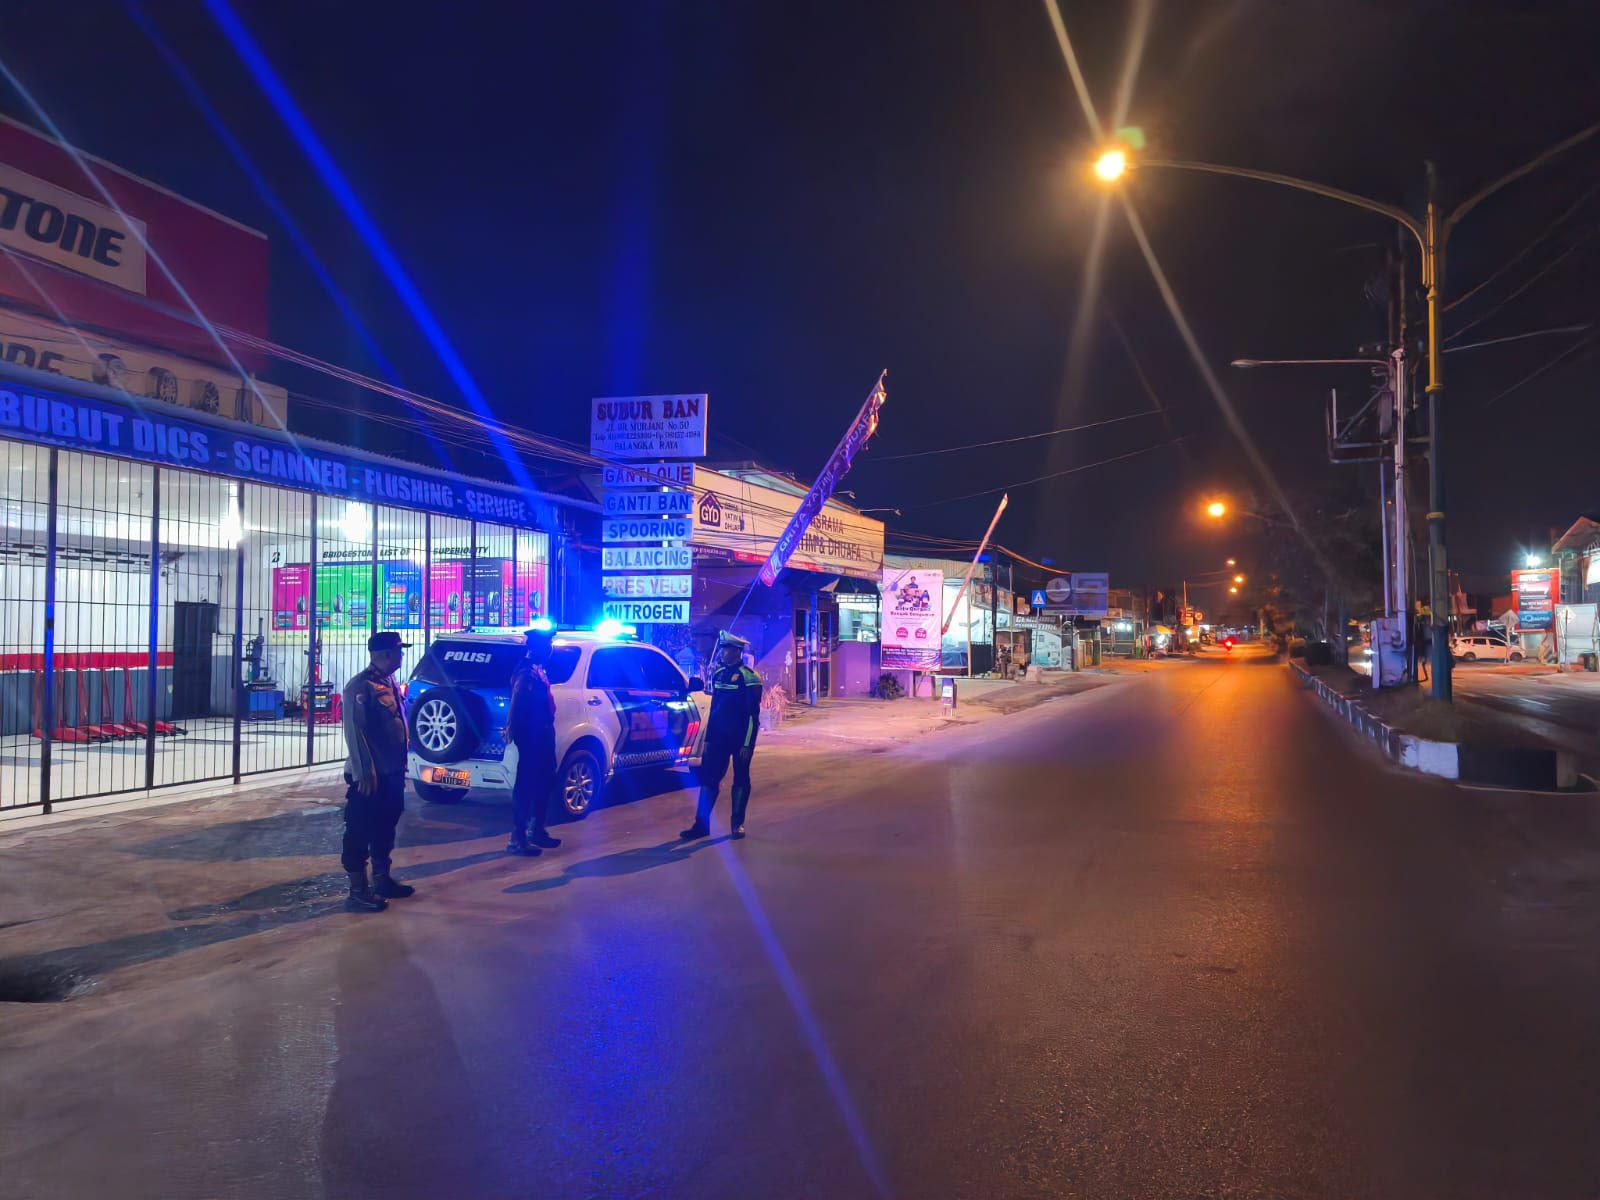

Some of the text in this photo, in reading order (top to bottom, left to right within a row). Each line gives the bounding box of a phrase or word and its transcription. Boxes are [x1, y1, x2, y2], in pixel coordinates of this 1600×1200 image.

[597, 399, 700, 420] SUBUR BAN
[630, 421, 664, 431] MURJANI
[614, 440, 679, 451] PALANGKA RAYA
[0, 390, 124, 447] BUBUT
[132, 418, 208, 465] DICS
[234, 440, 348, 491] SCANNER
[364, 468, 453, 508] FLUSHING
[466, 490, 527, 521] SERVICE
[605, 466, 691, 483] GANTI OLIE
[606, 494, 689, 512] GANTI BAN
[701, 504, 719, 523] GYD
[609, 522, 685, 539] SPOORING
[323, 550, 374, 559] BRIDGESTON
[829, 538, 861, 561] DHUAFA
[605, 550, 689, 567] BALANCING
[605, 577, 689, 595] PRES VELG
[607, 604, 683, 620] NITROGEN
[444, 651, 492, 664] POLISI
